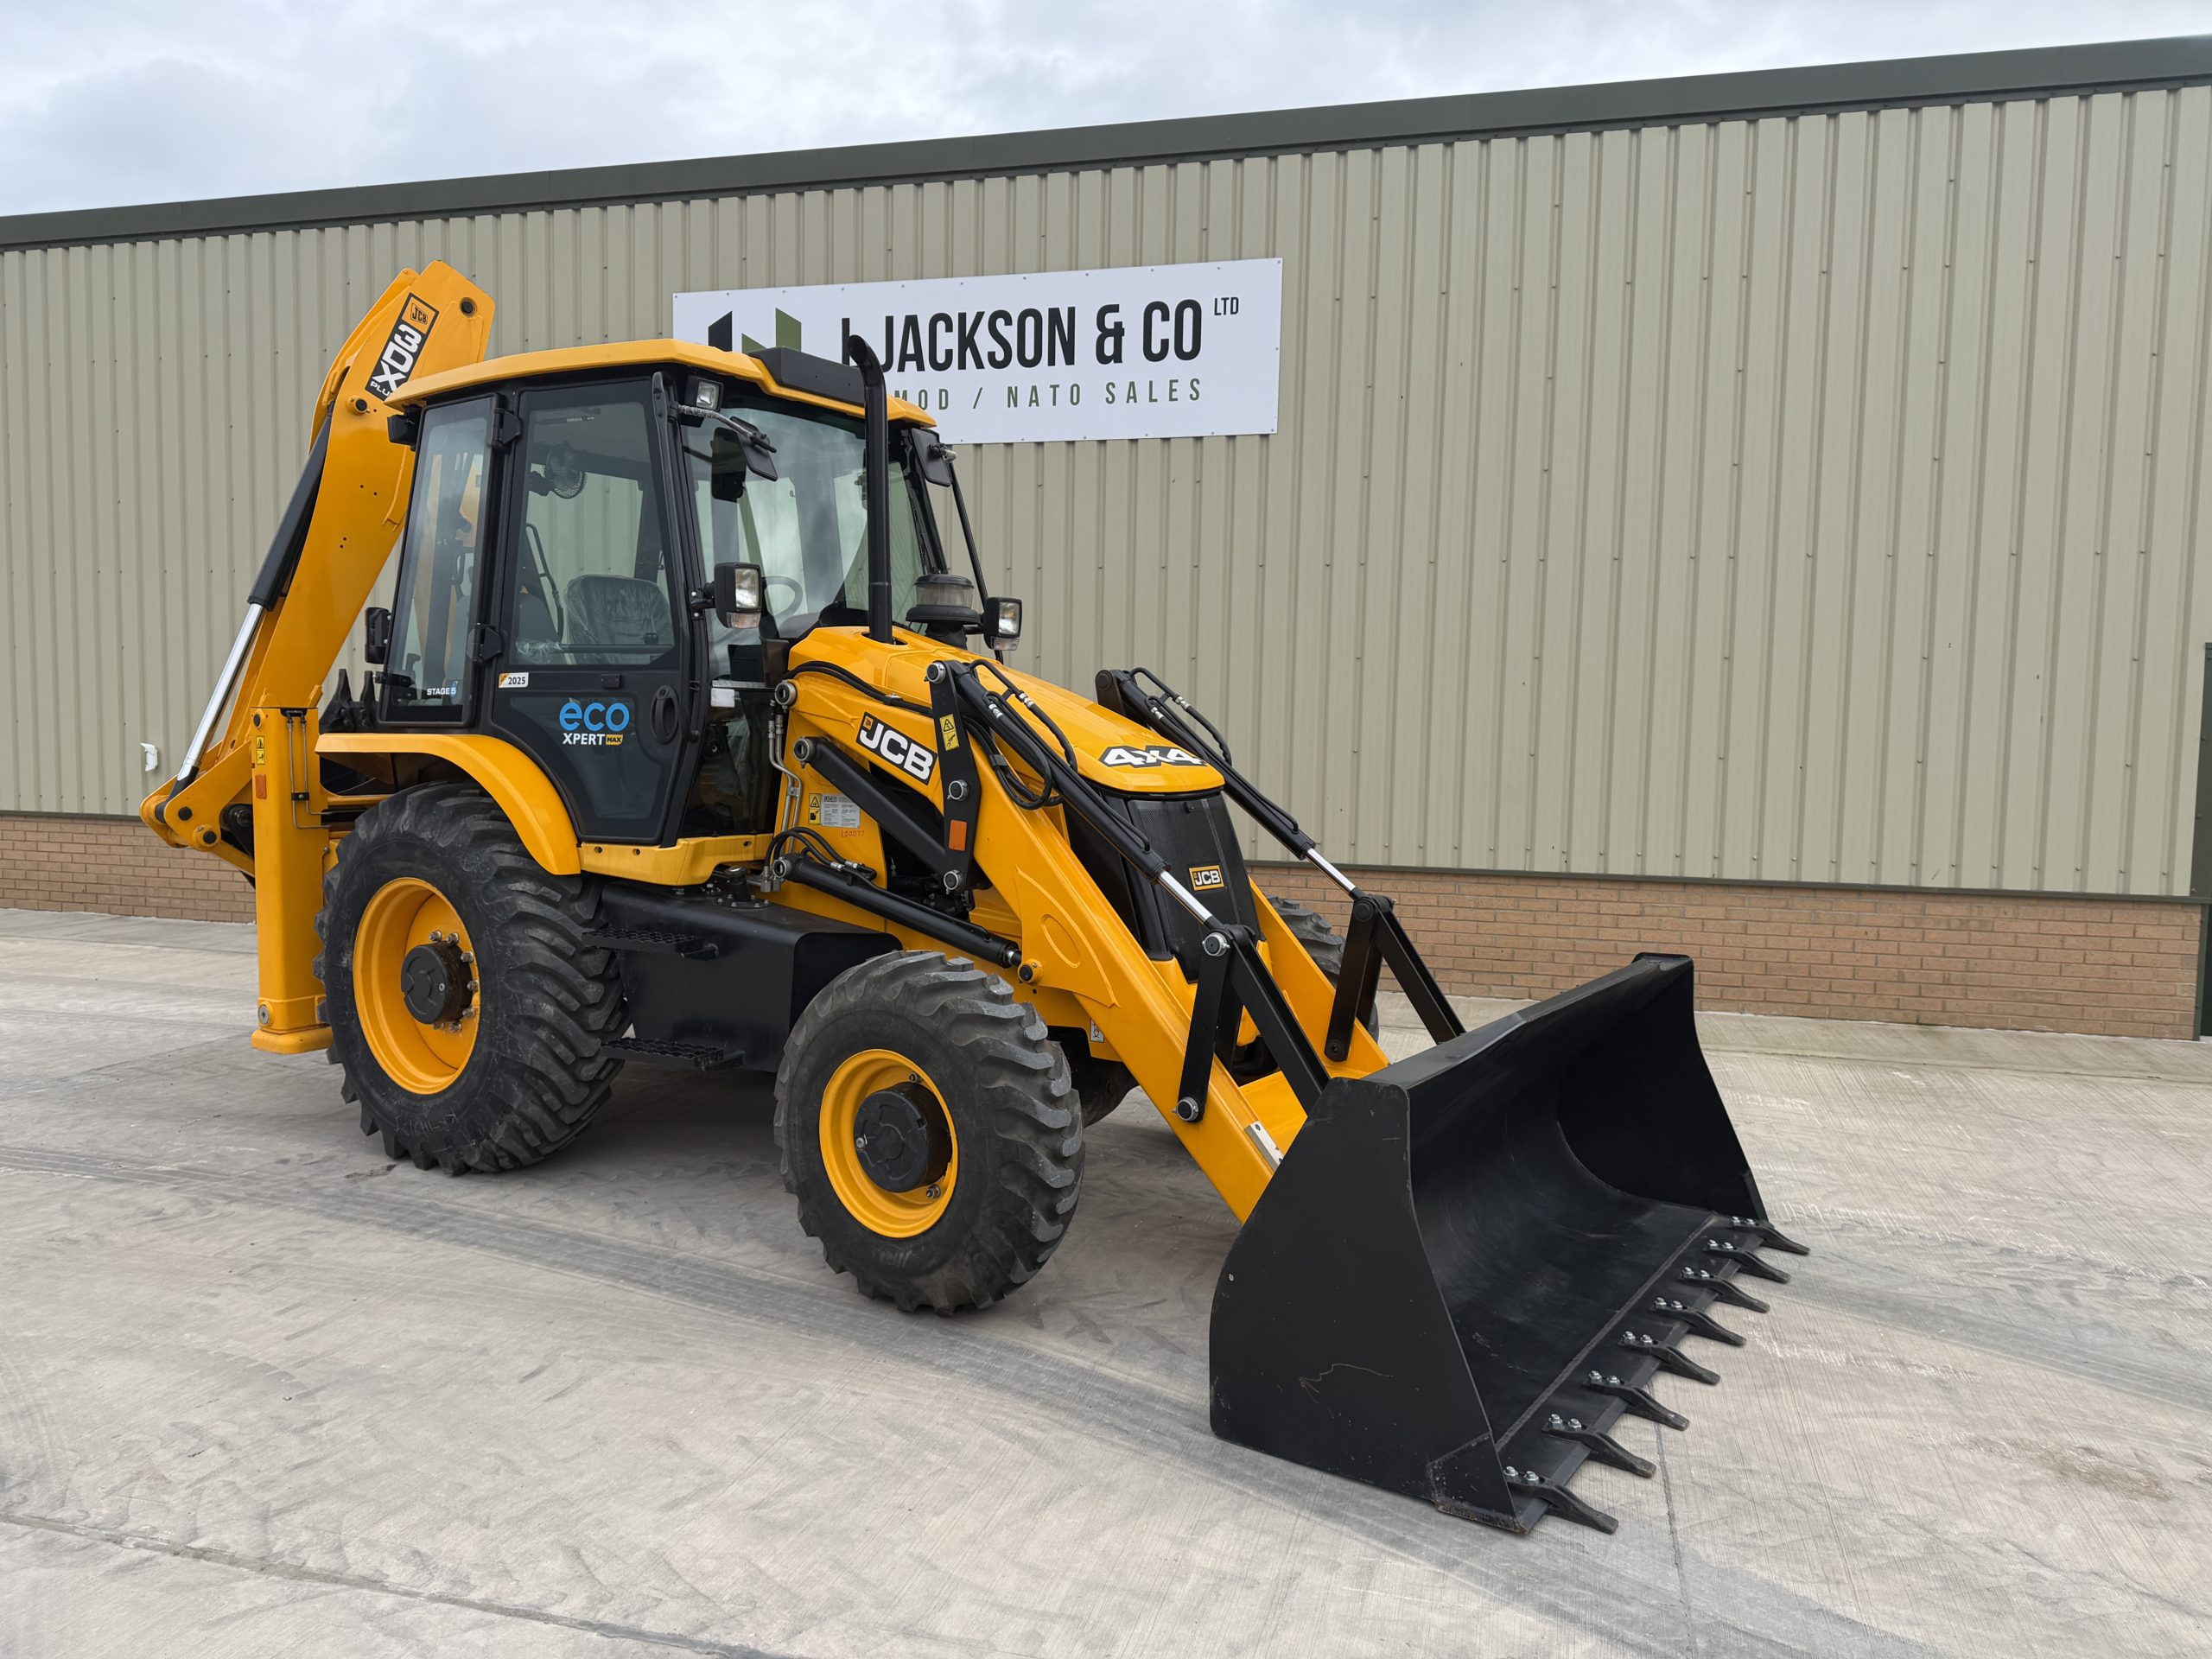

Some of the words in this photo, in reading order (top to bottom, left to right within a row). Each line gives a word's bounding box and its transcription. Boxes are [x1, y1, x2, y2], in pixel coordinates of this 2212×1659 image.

[411, 306, 427, 323] JCB
[881, 306, 1077, 373] JACKSON
[1096, 303, 1125, 365] &
[1142, 298, 1203, 363] CO
[1214, 296, 1240, 316] LTD
[370, 380, 391, 397] PLU
[1007, 383, 1081, 409] NATO
[1105, 378, 1201, 405] SALES
[508, 676, 526, 685] 2025
[559, 702, 630, 732] eco
[563, 733, 606, 746] XPERT
[860, 722, 934, 780] JCB
[1194, 869, 1221, 886] JCB
